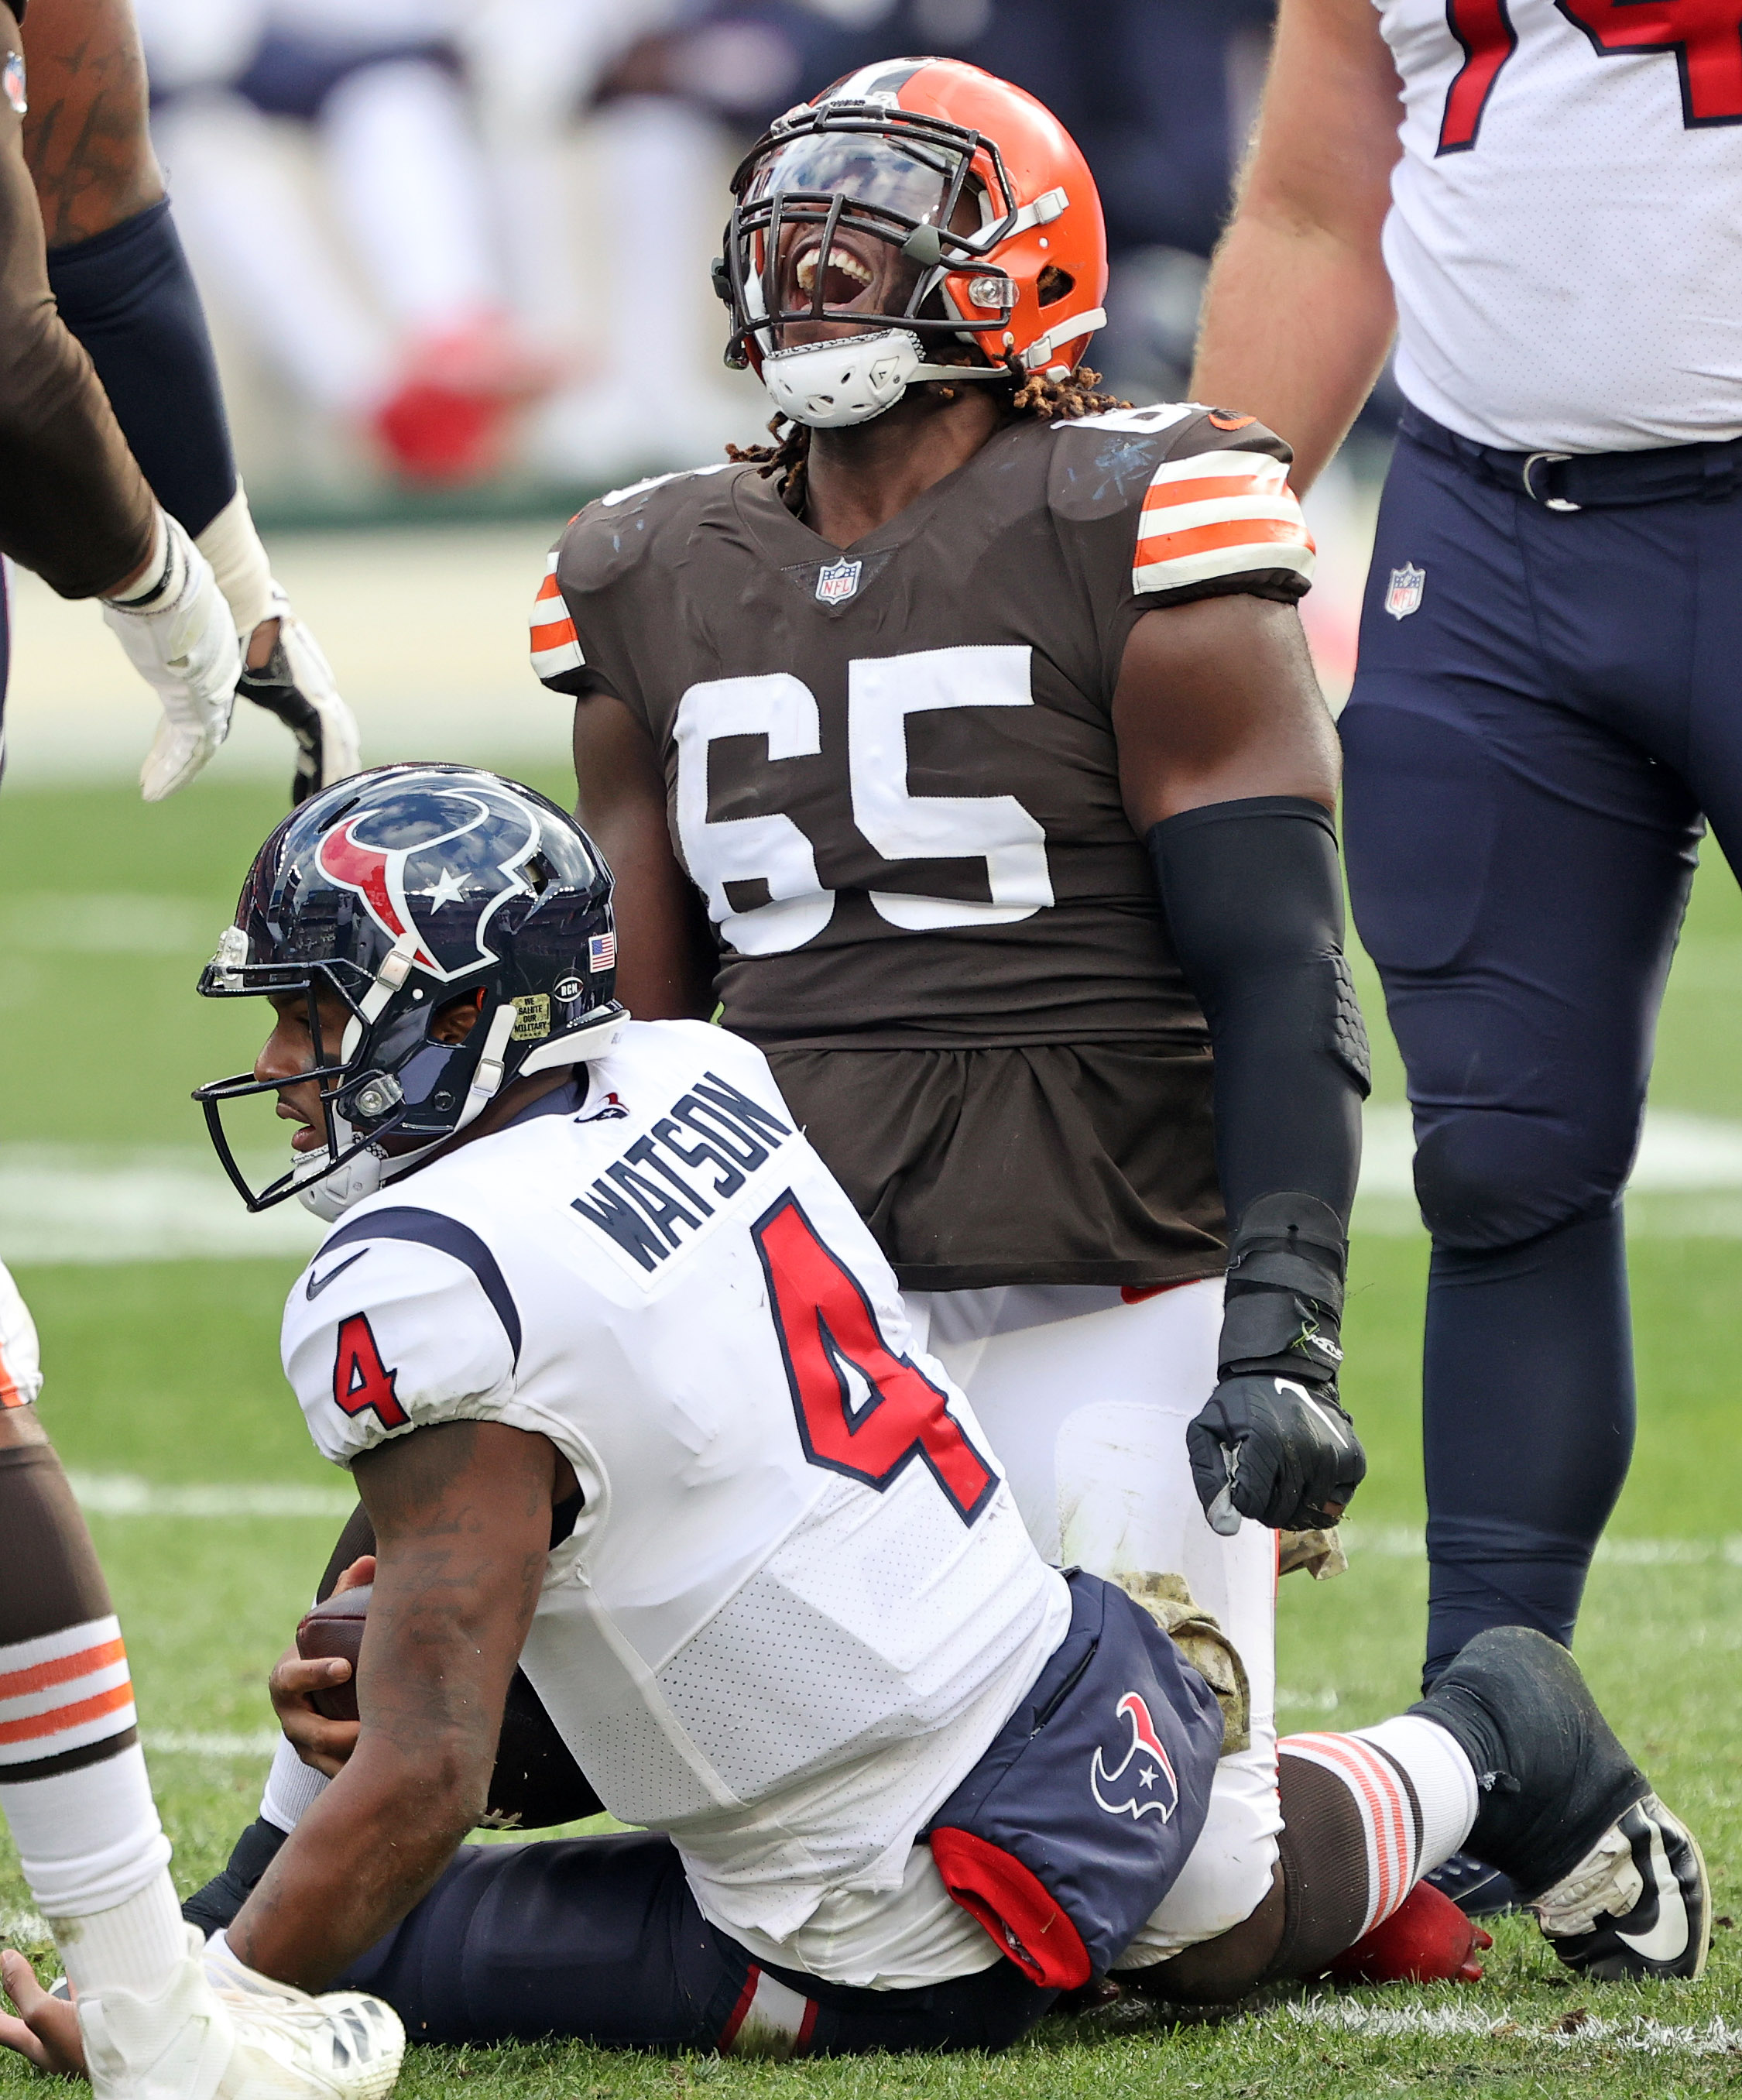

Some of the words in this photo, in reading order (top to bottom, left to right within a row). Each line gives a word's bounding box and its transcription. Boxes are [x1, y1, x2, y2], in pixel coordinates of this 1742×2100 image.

[823, 578, 850, 595] NFL
[1391, 589, 1415, 609] NFL
[672, 644, 1056, 956] 65
[561, 983, 578, 997] RCM
[518, 1005, 543, 1015] SALUTE
[524, 997, 535, 1006] WE
[514, 1021, 546, 1032] MILITARY
[523, 1014, 537, 1023] OUR
[570, 1071, 793, 1274] WATSON
[749, 1186, 1001, 1530] 4
[333, 1311, 412, 1432] 4
